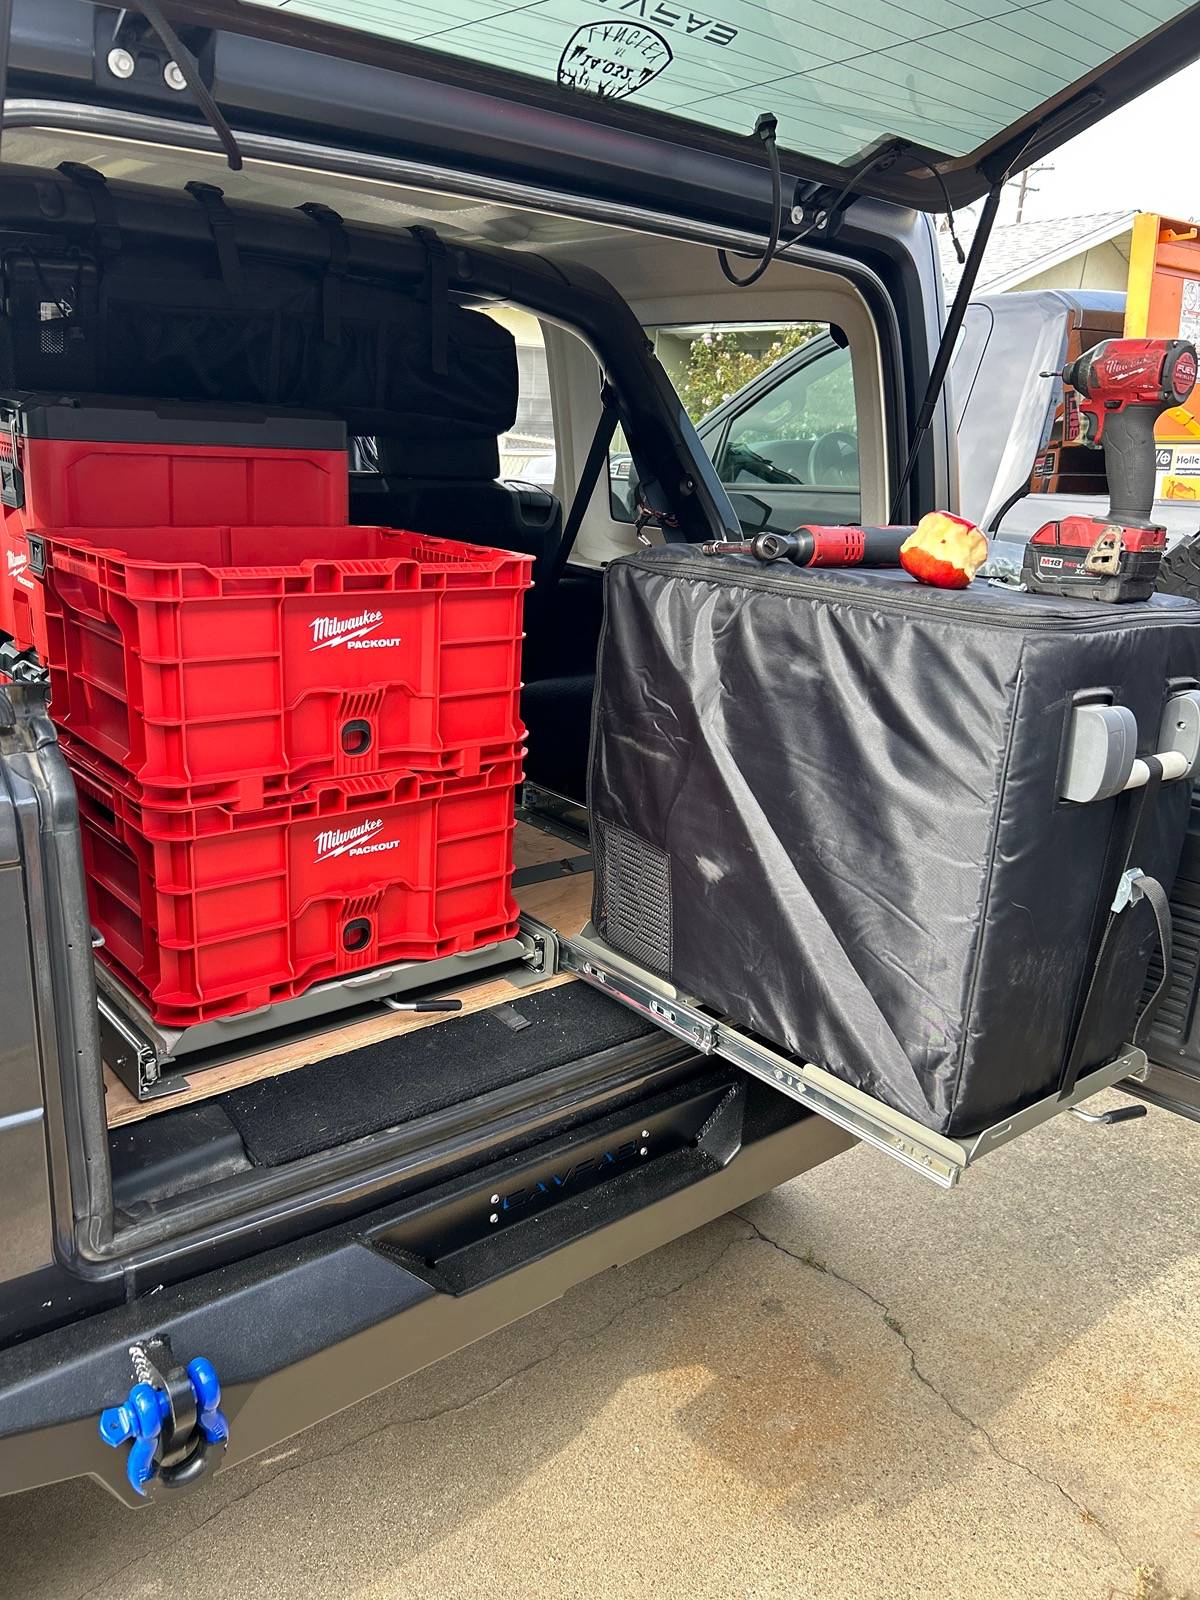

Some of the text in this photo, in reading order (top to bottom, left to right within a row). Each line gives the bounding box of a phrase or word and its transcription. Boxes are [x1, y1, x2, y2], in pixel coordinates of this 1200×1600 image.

[1176, 364, 1196, 376] FUEL
[1041, 558, 1062, 568] M18
[309, 610, 384, 642] Milwaukee
[347, 638, 401, 650] PACKOUT
[313, 819, 383, 855] Milwaukee
[349, 840, 400, 856] PACKOUT
